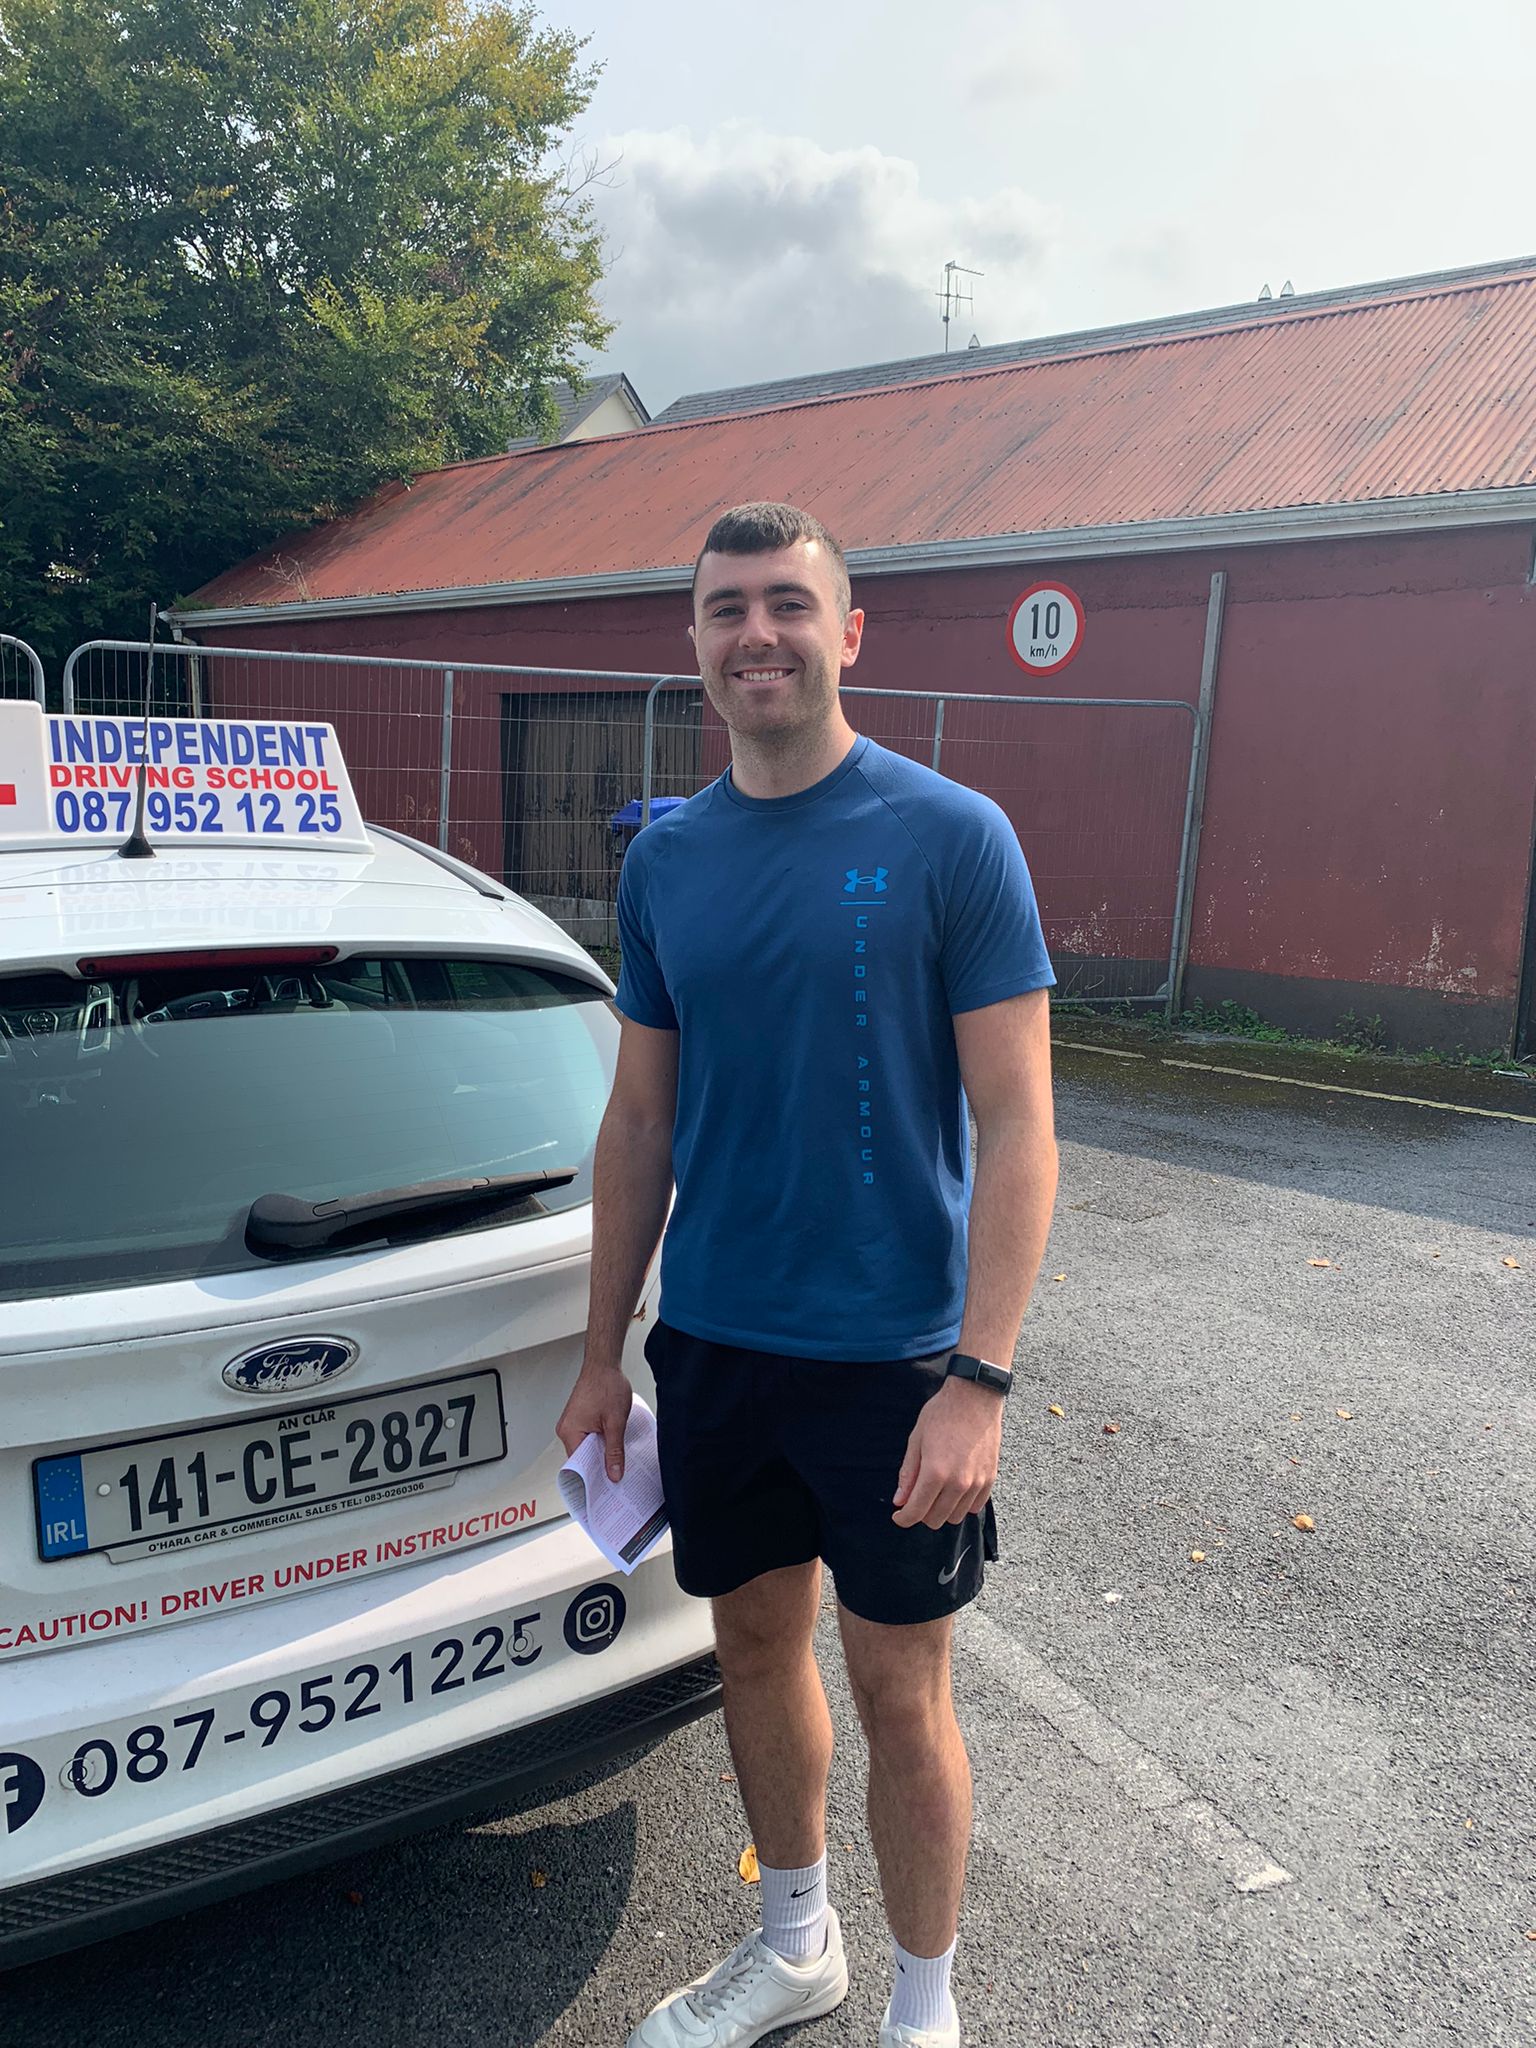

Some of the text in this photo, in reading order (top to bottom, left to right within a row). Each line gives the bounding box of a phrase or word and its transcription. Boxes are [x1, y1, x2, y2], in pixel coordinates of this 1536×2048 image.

[1031, 601, 1061, 640] 10
[1030, 643, 1058, 659] km/h
[50, 719, 328, 766] INDEPENDENT
[207, 766, 338, 791] SCHOOL
[55, 790, 342, 833] 087 952 12 25
[853, 915, 874, 1185] UNDER ARMOUR
[256, 1347, 329, 1384] Ford
[277, 1409, 336, 1431] AN CLÁR
[118, 1394, 476, 1532] 141-CE-2827
[45, 1519, 85, 1545] IRL
[148, 1481, 425, 1552] O'HARA CAR & COMMERCIAL SALES TEL: 083-0260306
[0, 1500, 537, 1649] CAUTION! DRIVER UNDER INSTRUCTION
[72, 1612, 542, 1797] 087-9521225
